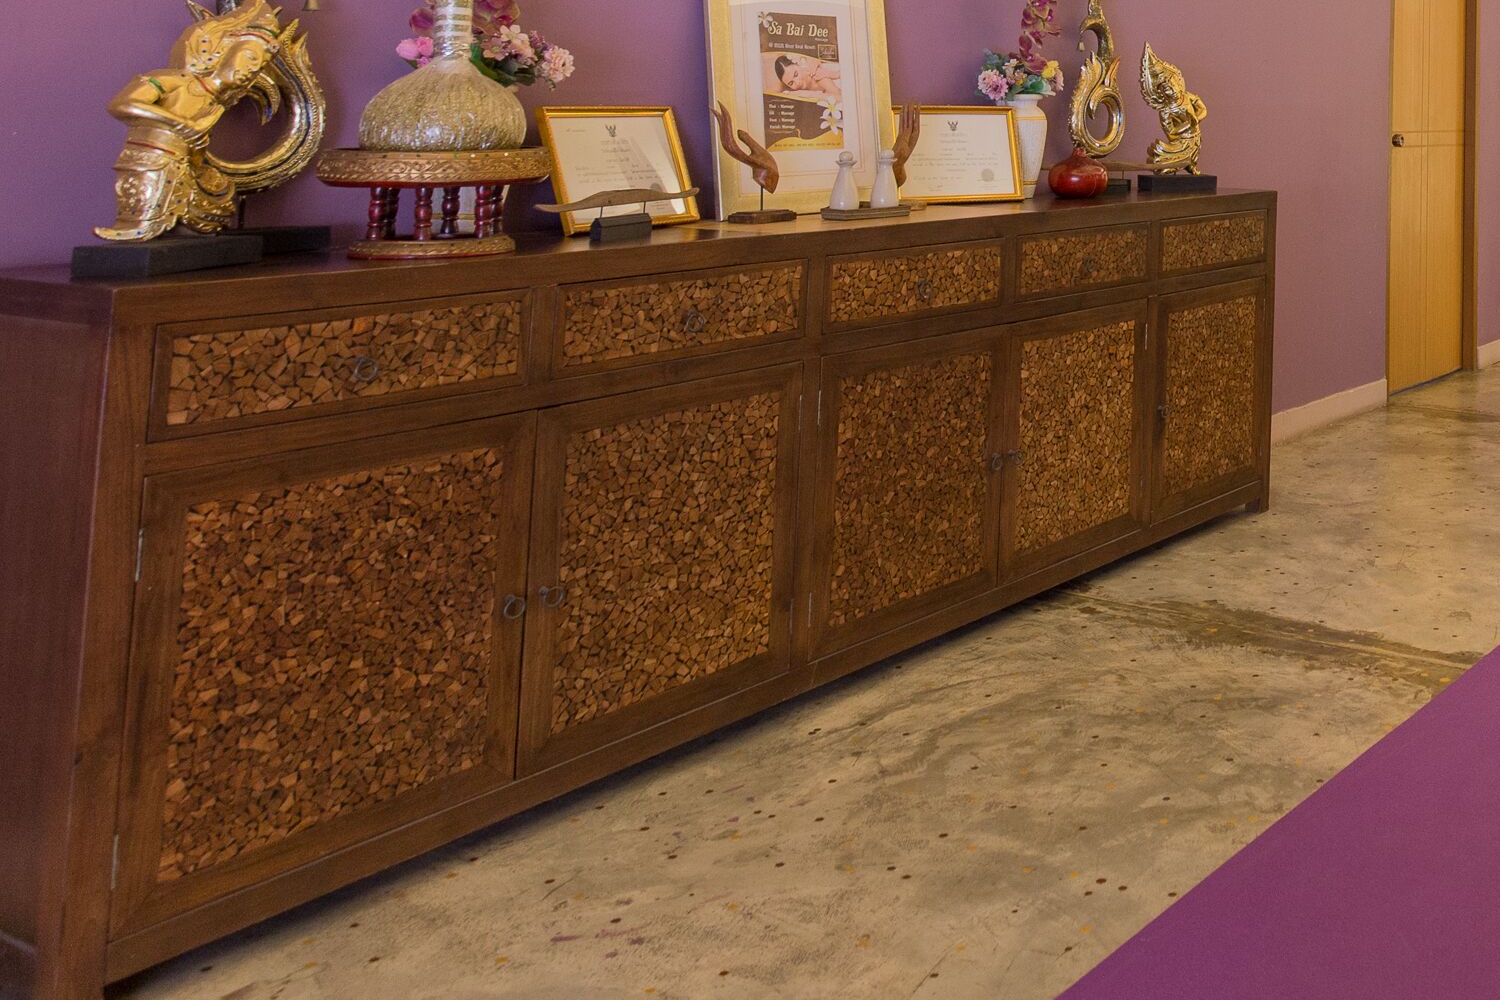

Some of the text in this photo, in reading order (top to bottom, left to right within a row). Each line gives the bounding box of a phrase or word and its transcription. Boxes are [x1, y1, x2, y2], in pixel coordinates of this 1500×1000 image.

[767, 21, 828, 38] Sa Bai Dee
